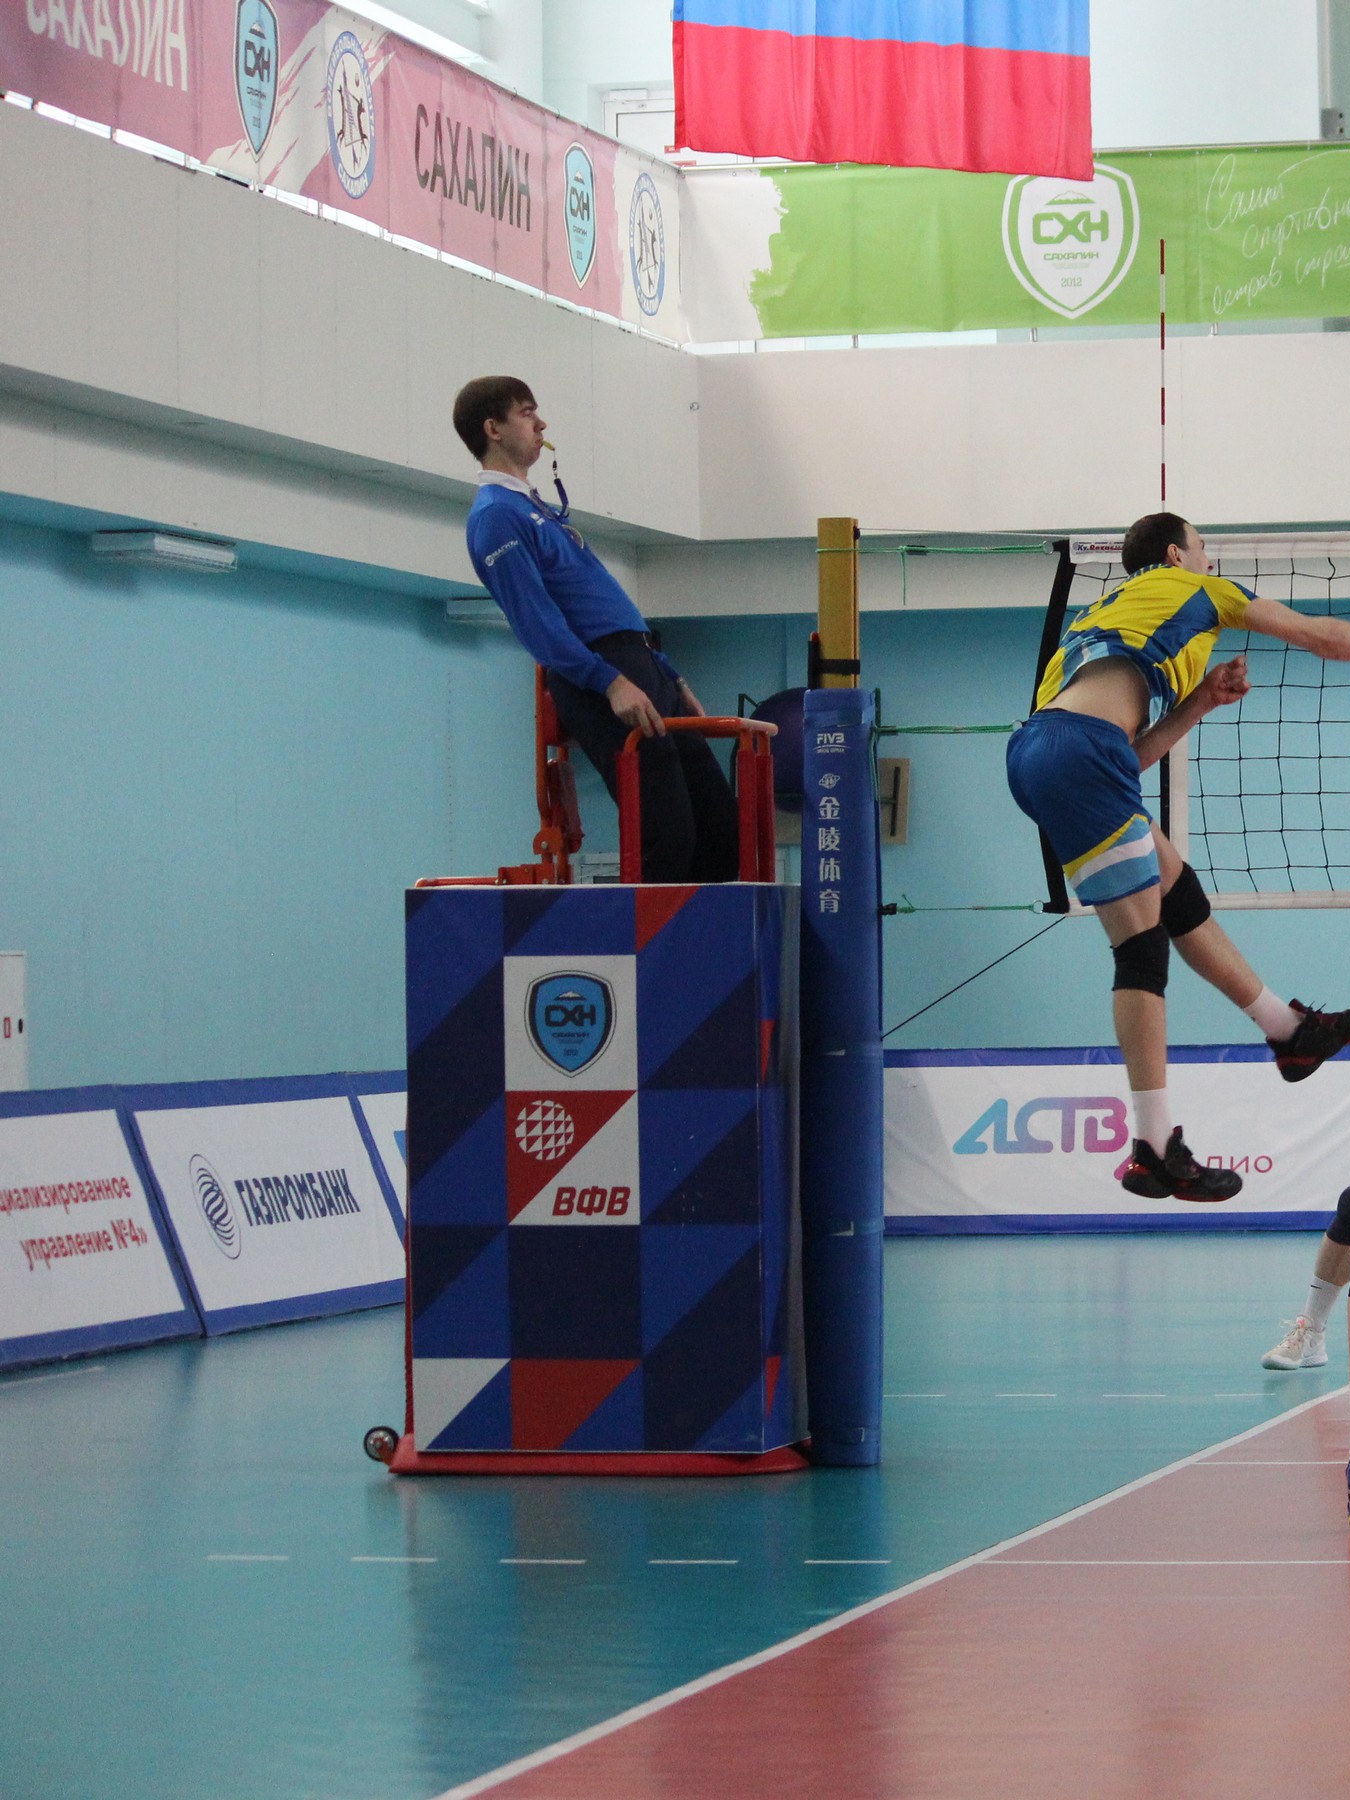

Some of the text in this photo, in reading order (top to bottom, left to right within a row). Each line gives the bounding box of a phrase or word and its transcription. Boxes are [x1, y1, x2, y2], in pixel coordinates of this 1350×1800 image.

[415, 103, 531, 232] САХАЛИН
[1043, 251, 1099, 261] САХАЛИН
[1060, 277, 1083, 288] 2012
[816, 732, 845, 745] FIVB
[818, 796, 841, 914] 金陵体育
[234, 1168, 361, 1227] ГАЗПРОМБАНК
[552, 1186, 631, 1216] ВФВ
[20, 1229, 113, 1271] управление
